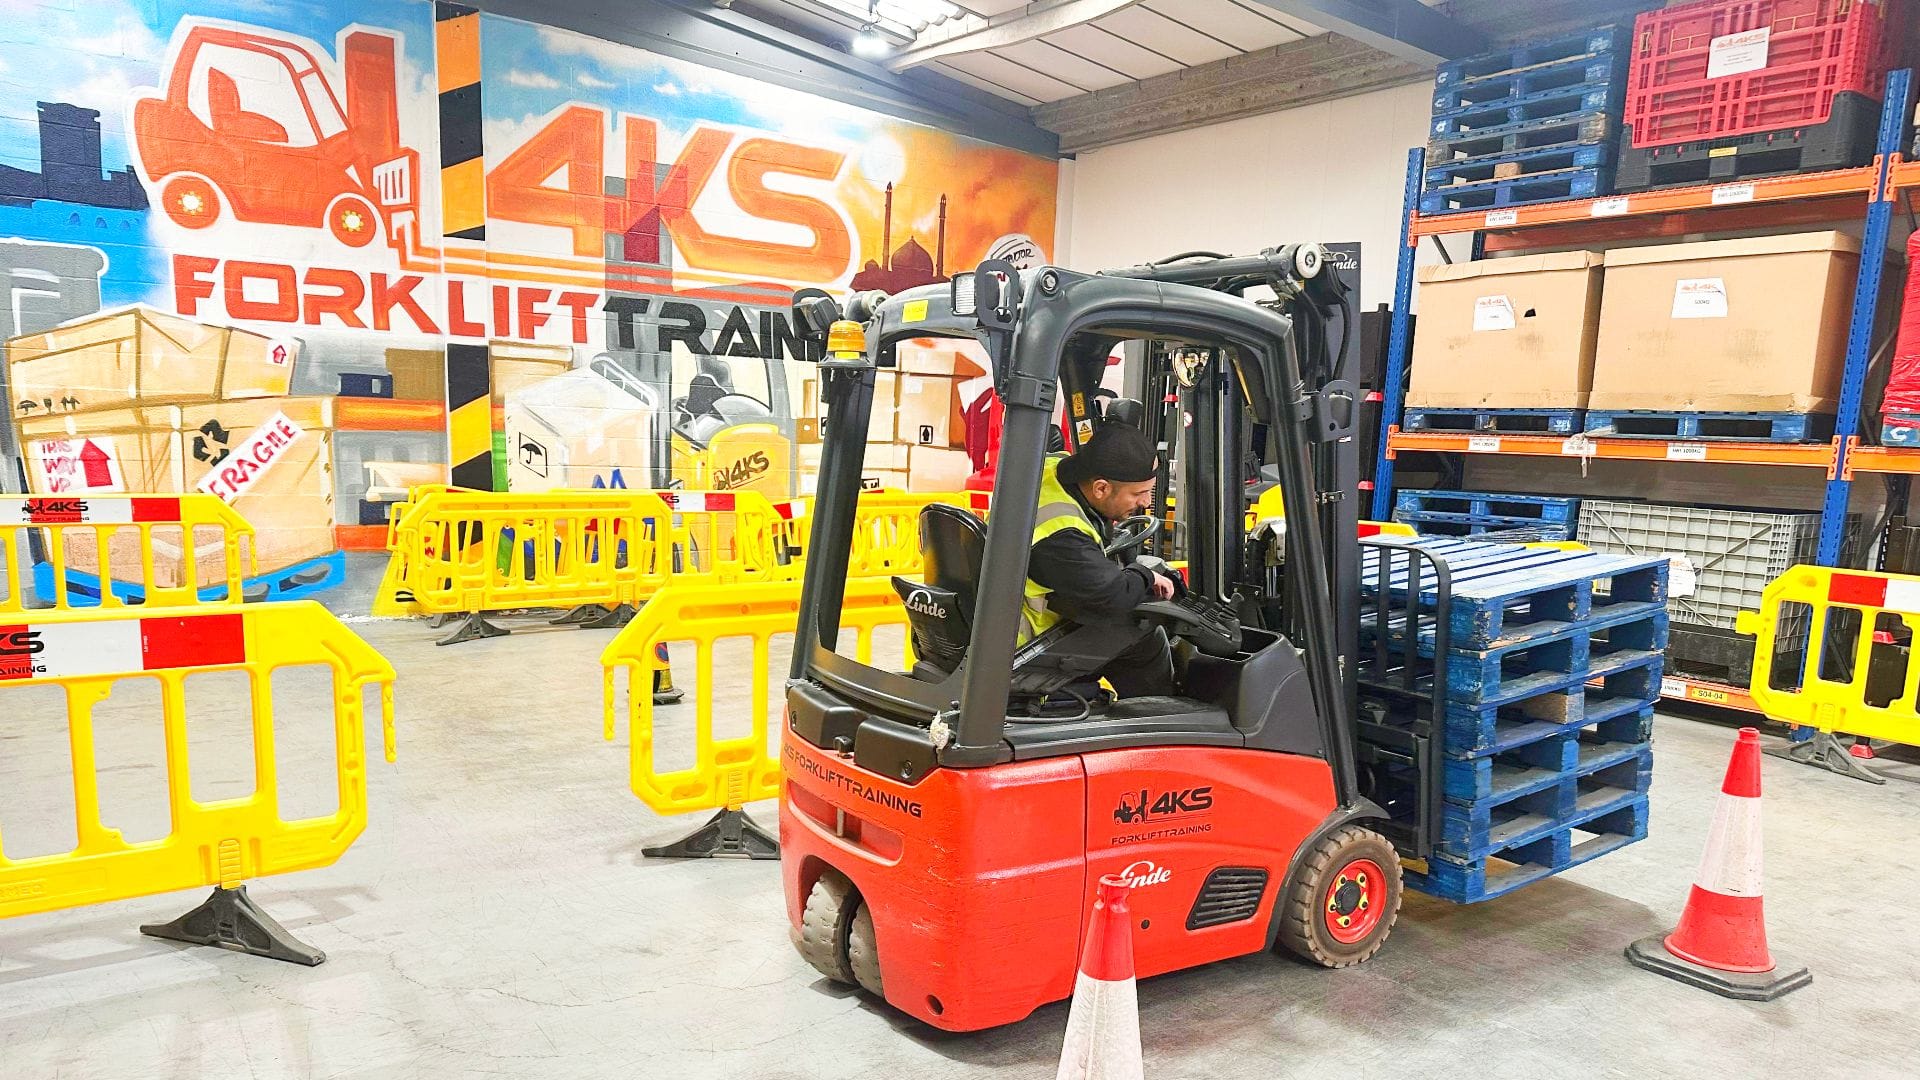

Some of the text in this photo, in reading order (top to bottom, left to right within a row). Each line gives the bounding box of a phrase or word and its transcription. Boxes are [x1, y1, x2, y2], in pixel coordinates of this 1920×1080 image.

[486, 106, 851, 283] 4KS
[173, 254, 599, 344] FORKLIFT
[43, 456, 76, 475] WAY
[208, 420, 297, 502] FRAGILE
[731, 451, 769, 479] 4KS
[49, 477, 71, 493] UP
[46, 501, 88, 512] 4KS
[905, 590, 947, 619] Linde
[1150, 787, 1213, 814] 4KS
